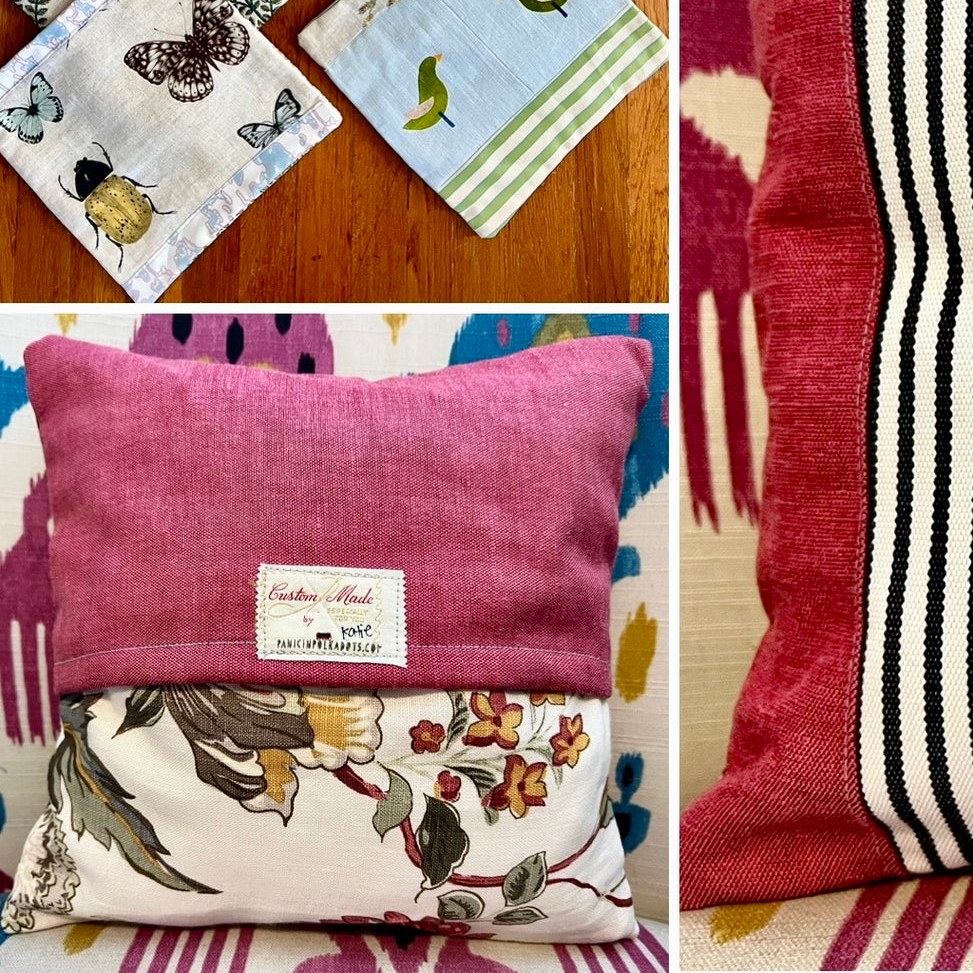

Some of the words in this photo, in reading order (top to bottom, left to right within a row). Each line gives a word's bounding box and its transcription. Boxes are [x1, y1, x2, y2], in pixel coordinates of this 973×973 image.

[268, 582, 318, 602] Custom
[326, 584, 374, 605] Made
[326, 607, 369, 616] ESPECIALLY
[302, 615, 314, 626] by
[349, 615, 365, 623] YOU
